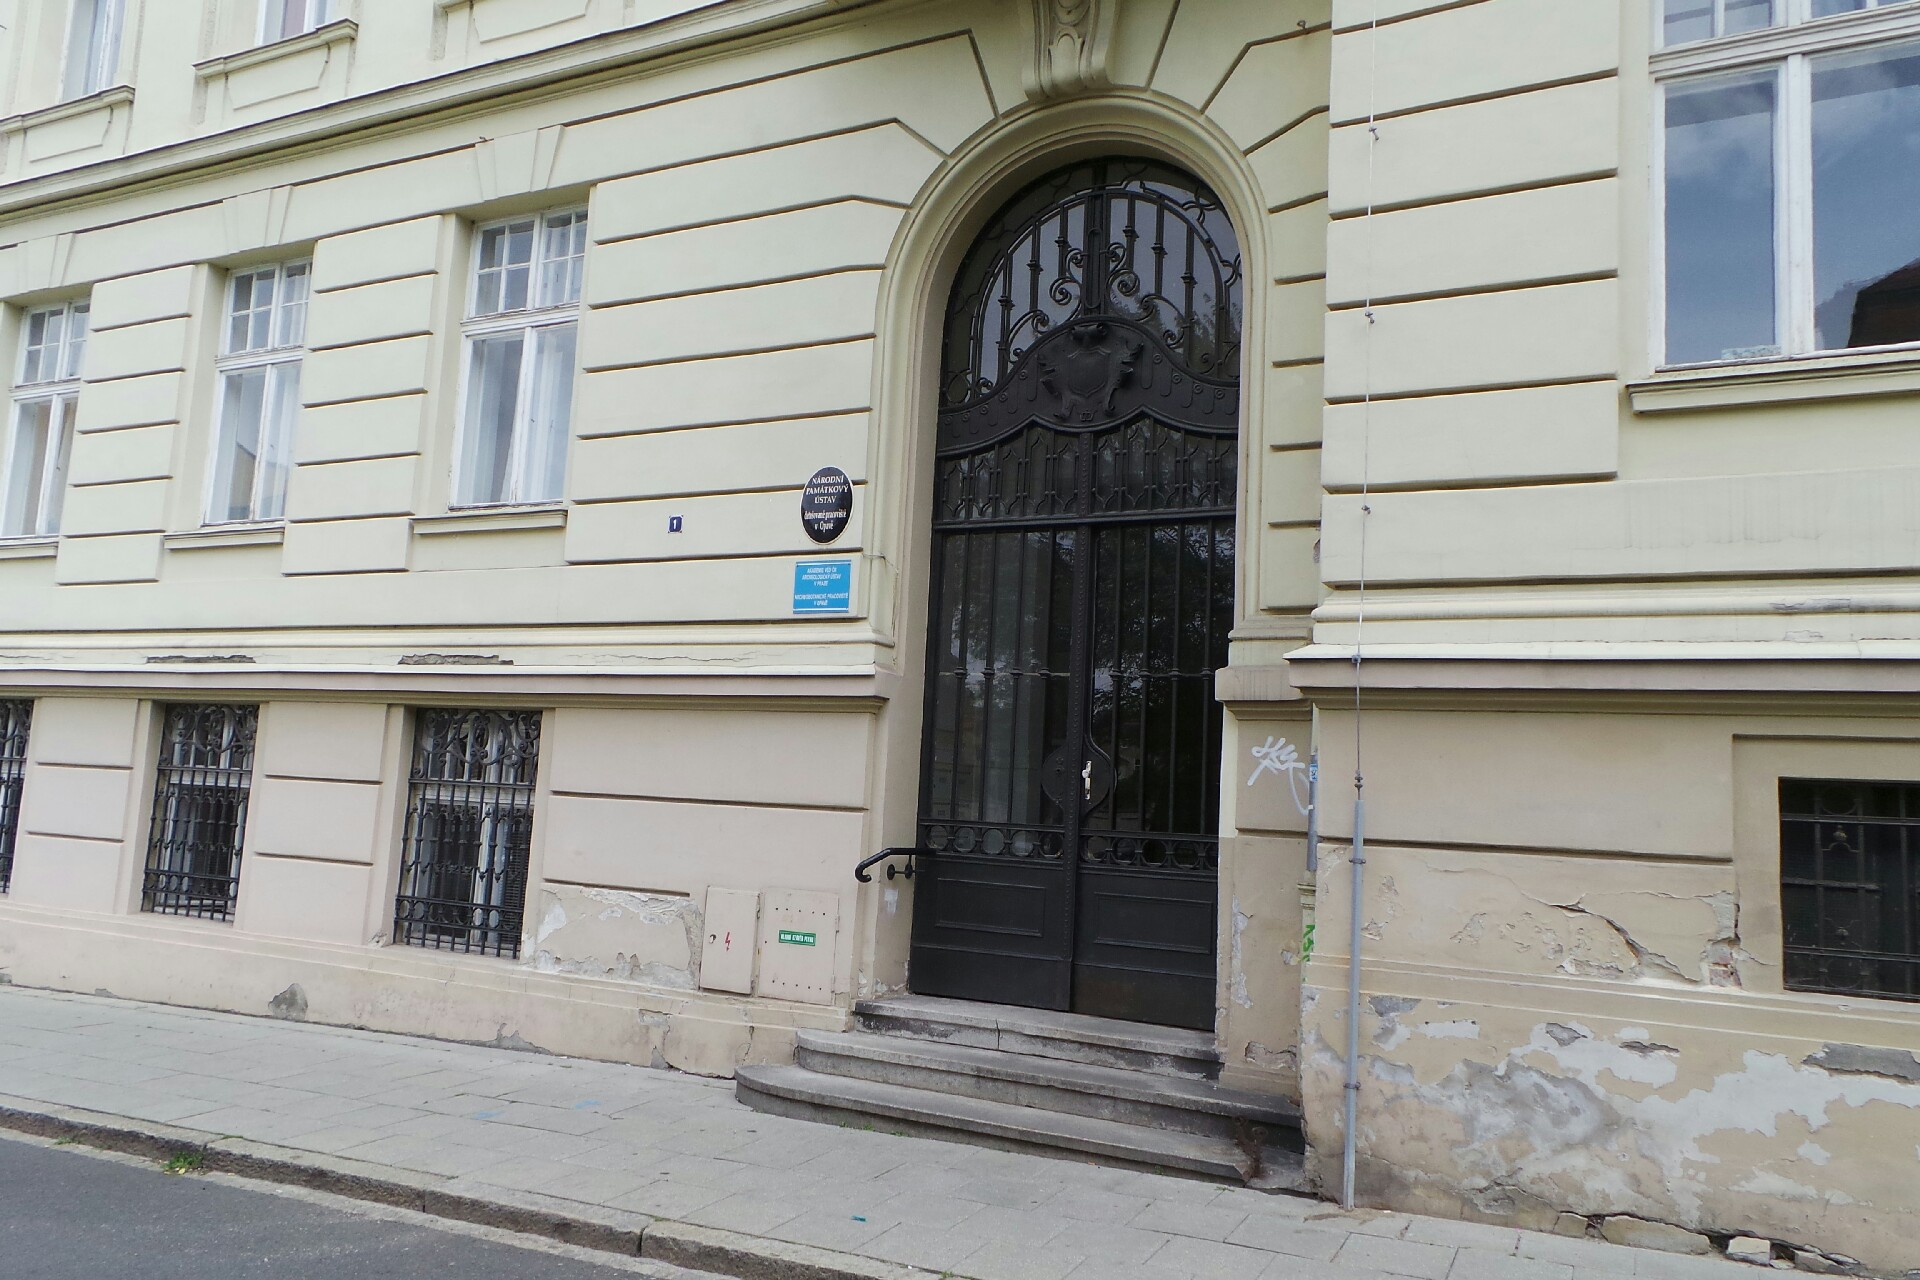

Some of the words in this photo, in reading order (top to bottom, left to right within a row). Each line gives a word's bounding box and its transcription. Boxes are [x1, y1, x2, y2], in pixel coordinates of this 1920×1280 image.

[812, 475, 844, 485] NÁRODNÍ
[806, 484, 849, 495] PAMÁTKOVÝ
[814, 495, 836, 504] ÚSTAV
[820, 520, 833, 532] Opavě
